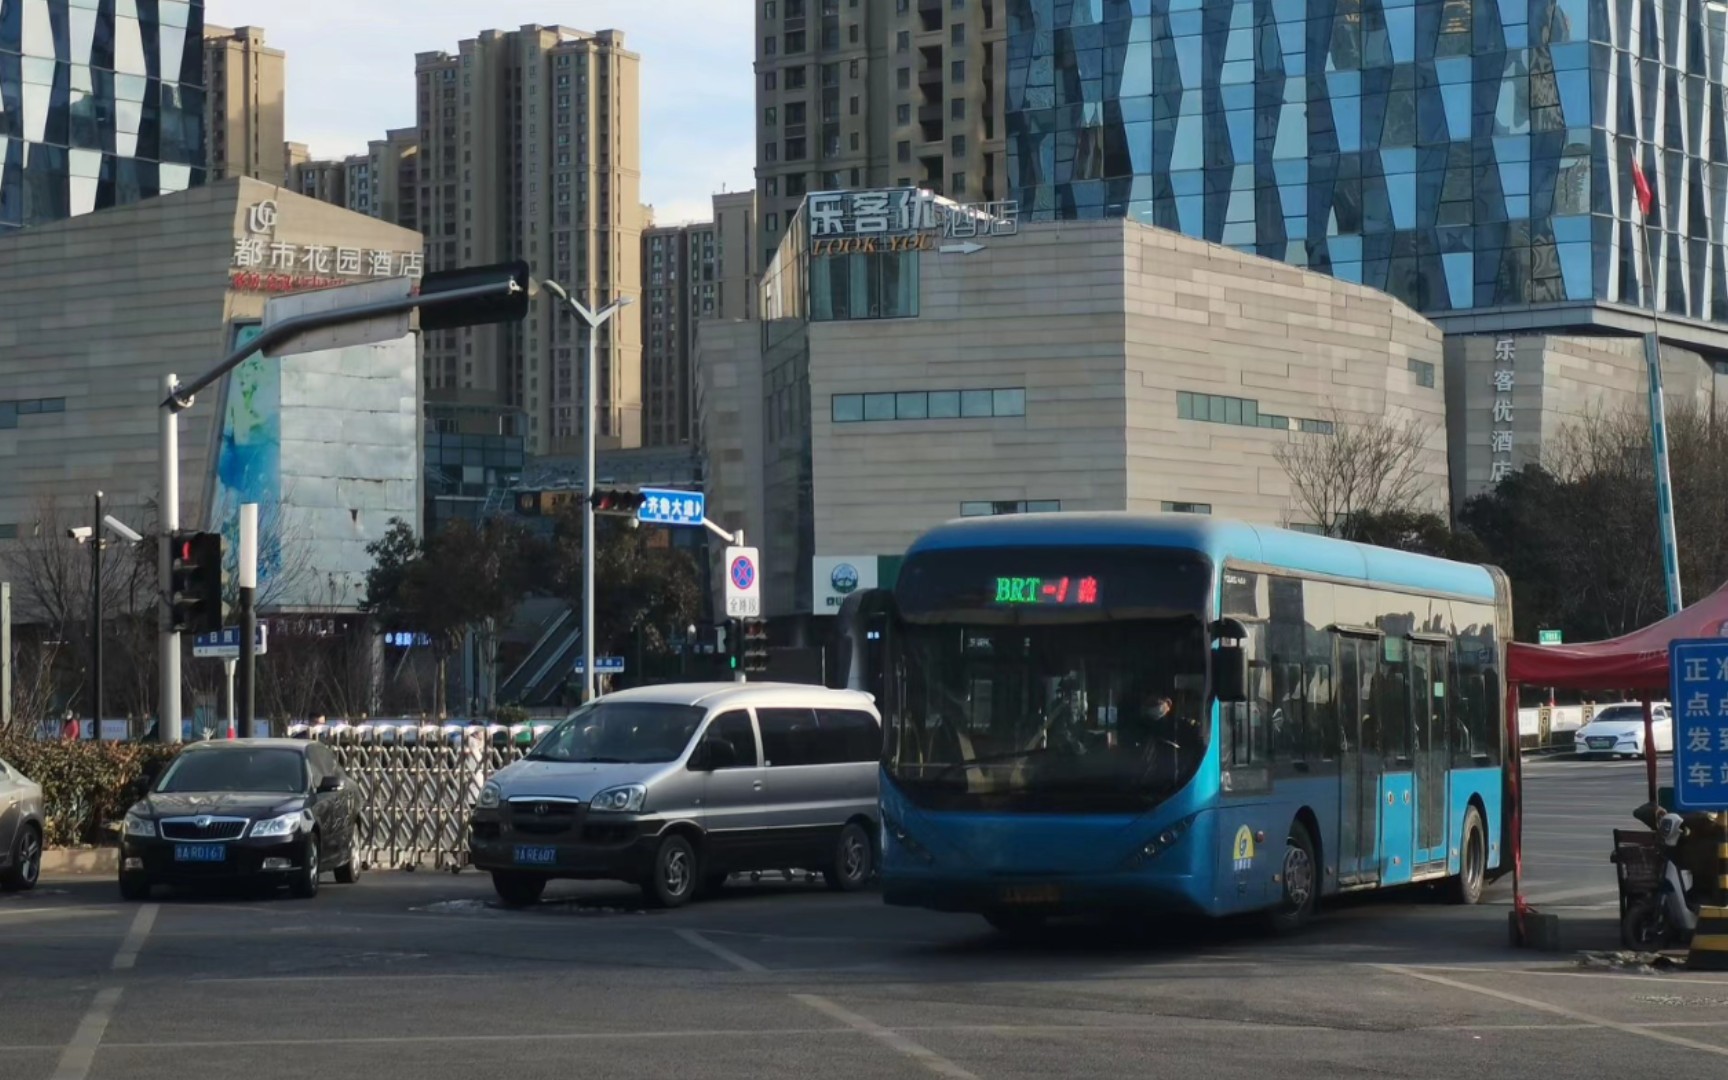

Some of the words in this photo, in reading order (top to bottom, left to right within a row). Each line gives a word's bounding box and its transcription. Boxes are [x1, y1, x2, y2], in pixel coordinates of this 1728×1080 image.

[810, 190, 1018, 237] 乐客优酒店
[234, 239, 424, 279] 都市花园酒店
[813, 237, 877, 256] LOOK
[889, 233, 934, 251] YOU
[1490, 339, 1515, 483] 乐客优酒店
[1684, 657, 1713, 788] 正点发车
